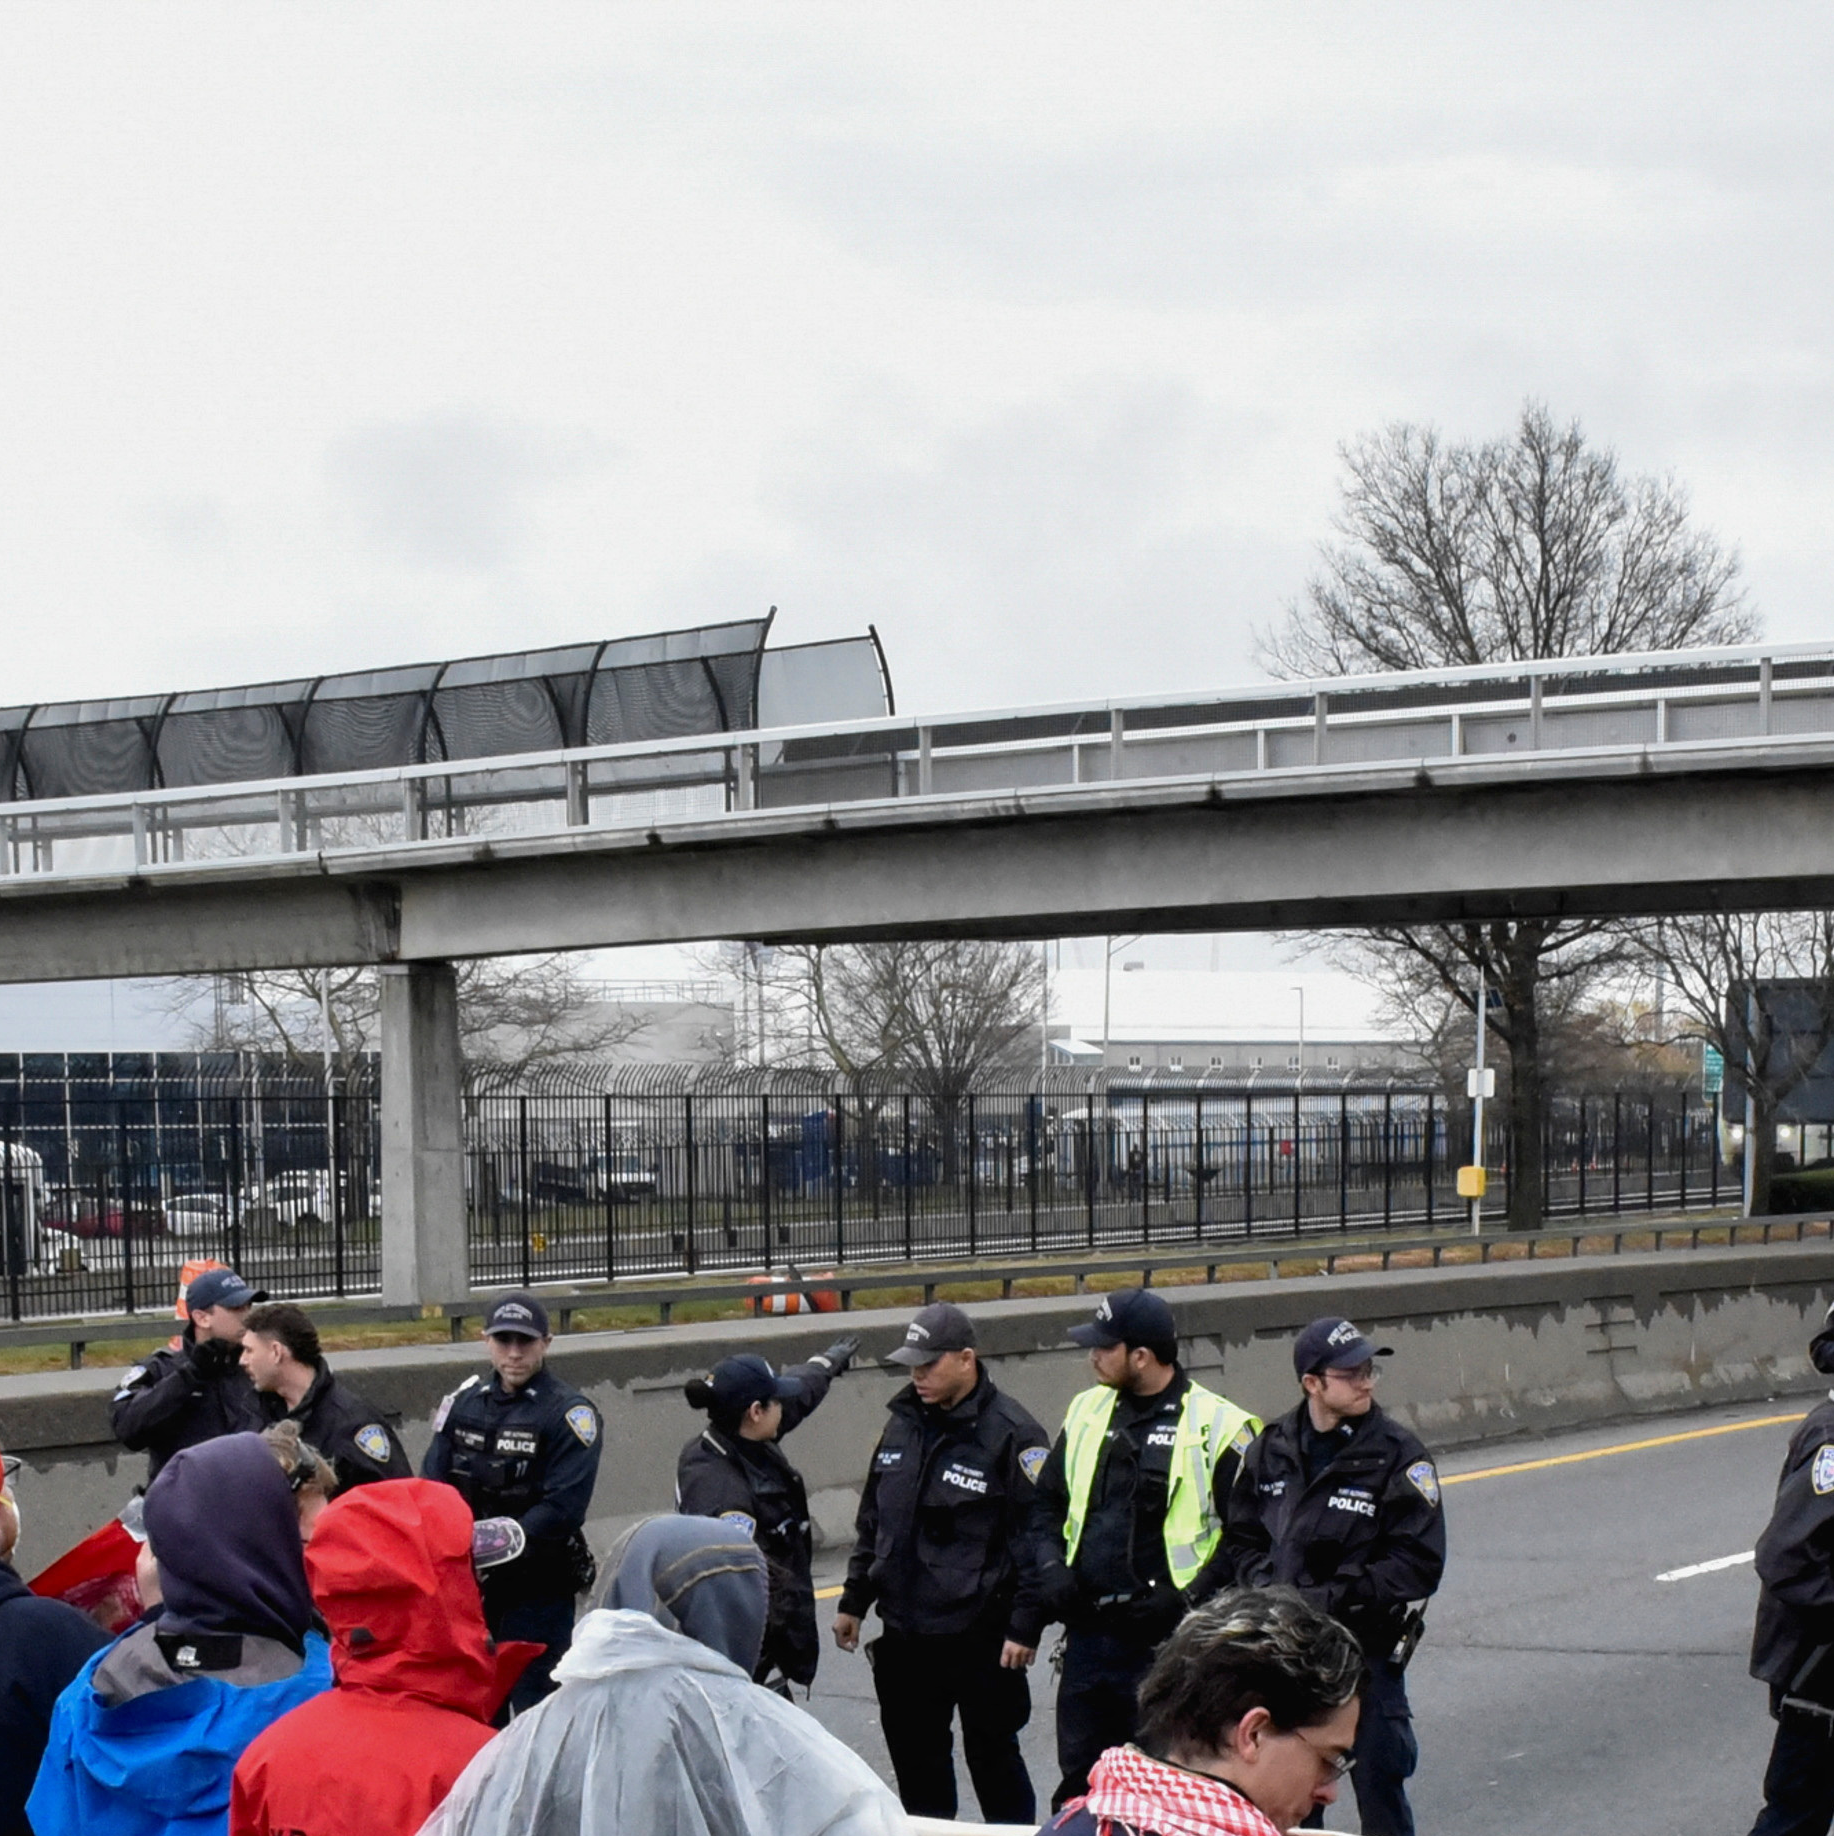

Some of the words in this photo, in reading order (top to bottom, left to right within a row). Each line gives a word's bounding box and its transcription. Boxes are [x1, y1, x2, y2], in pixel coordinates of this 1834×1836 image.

[497, 1439, 537, 1453] POLICE
[1147, 1433, 1176, 1446] POLI
[943, 1470, 987, 1493] POLICE
[1328, 1496, 1376, 1518] POLICE
